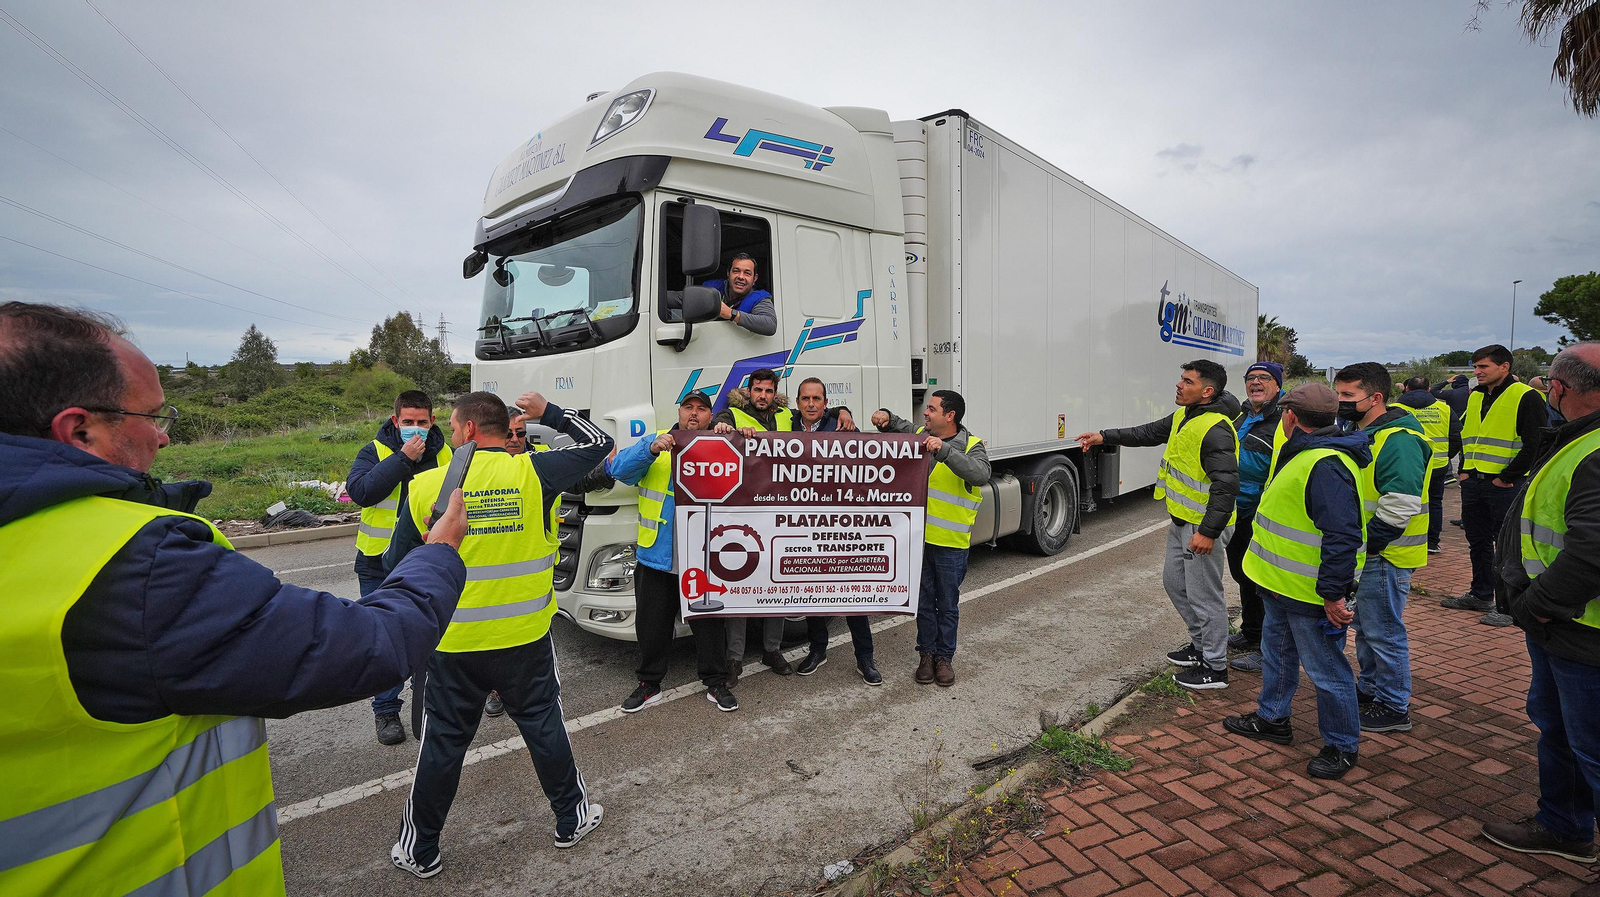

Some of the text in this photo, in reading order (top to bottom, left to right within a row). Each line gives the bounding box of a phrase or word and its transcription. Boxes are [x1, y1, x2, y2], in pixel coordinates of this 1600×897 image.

[969, 130, 984, 149] FRC
[888, 264, 899, 341] CARMEN
[1192, 315, 1222, 341] GILABERT
[555, 376, 574, 390] FRAN
[745, 438, 923, 460] PARO NACIONAL
[682, 461, 738, 477] STOP
[772, 464, 896, 484] INDEFINIDO
[463, 488, 520, 497] PLATAFORMA
[753, 487, 912, 503] desde las 00h del 14 de Marzo
[775, 514, 892, 528] PLATAFORMA
[812, 532, 862, 541] DEFENSA
[816, 543, 885, 552] TRANSPORTE
[793, 557, 837, 565] MERCANCIAS
[849, 556, 886, 564] CARRETERA
[828, 565, 886, 573] INTERNACIONAL
[729, 587, 740, 595] 648
[741, 587, 751, 595] 057
[753, 586, 762, 594] 615
[767, 586, 777, 594] 659
[779, 586, 789, 594] 165
[789, 586, 799, 594] 710
[803, 586, 814, 594] 646
[815, 585, 825, 594] 051
[826, 585, 836, 593] 562
[840, 585, 850, 593] 616
[851, 585, 861, 593] 990
[862, 585, 871, 593] 528
[876, 585, 886, 593] 637
[886, 585, 897, 593] 760
[898, 585, 908, 593] 024
[756, 594, 889, 606] www.plataformanacional.es
